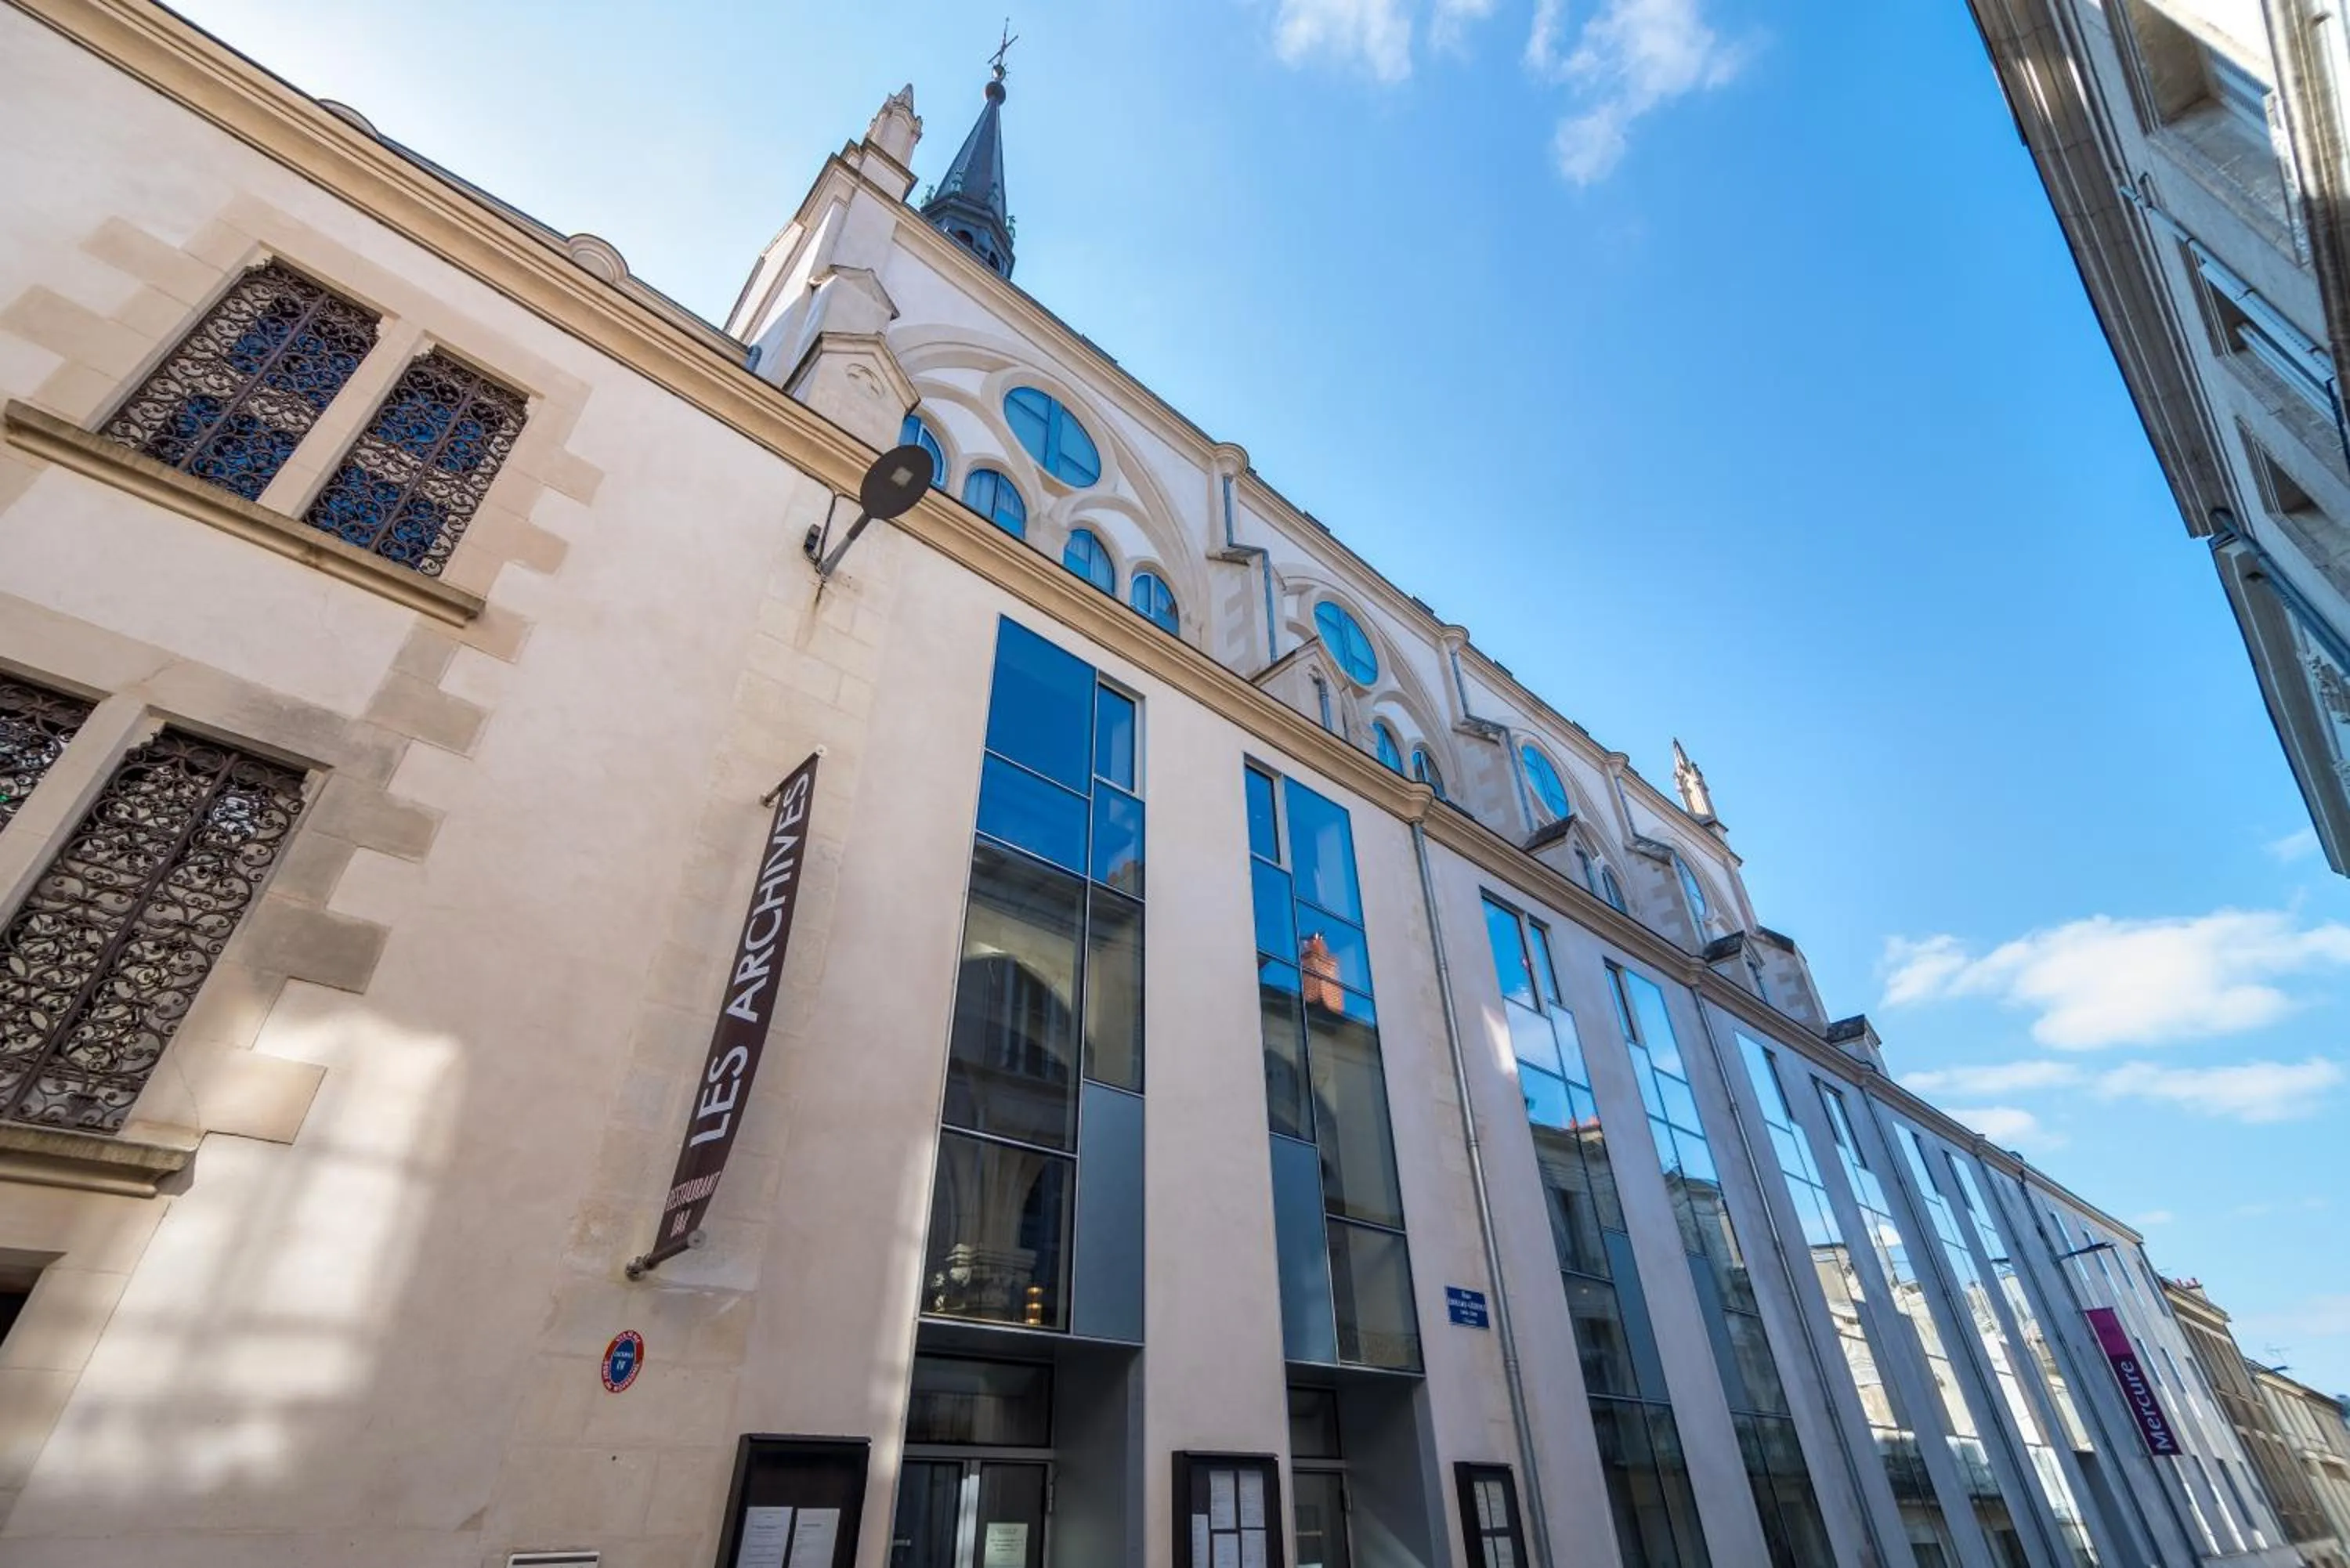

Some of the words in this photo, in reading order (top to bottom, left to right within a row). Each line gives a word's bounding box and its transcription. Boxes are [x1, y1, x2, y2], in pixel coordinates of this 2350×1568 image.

[689, 1046, 748, 1147] LES
[726, 771, 809, 1023] ARCHIVES
[2120, 1360, 2174, 1450] Mercure
